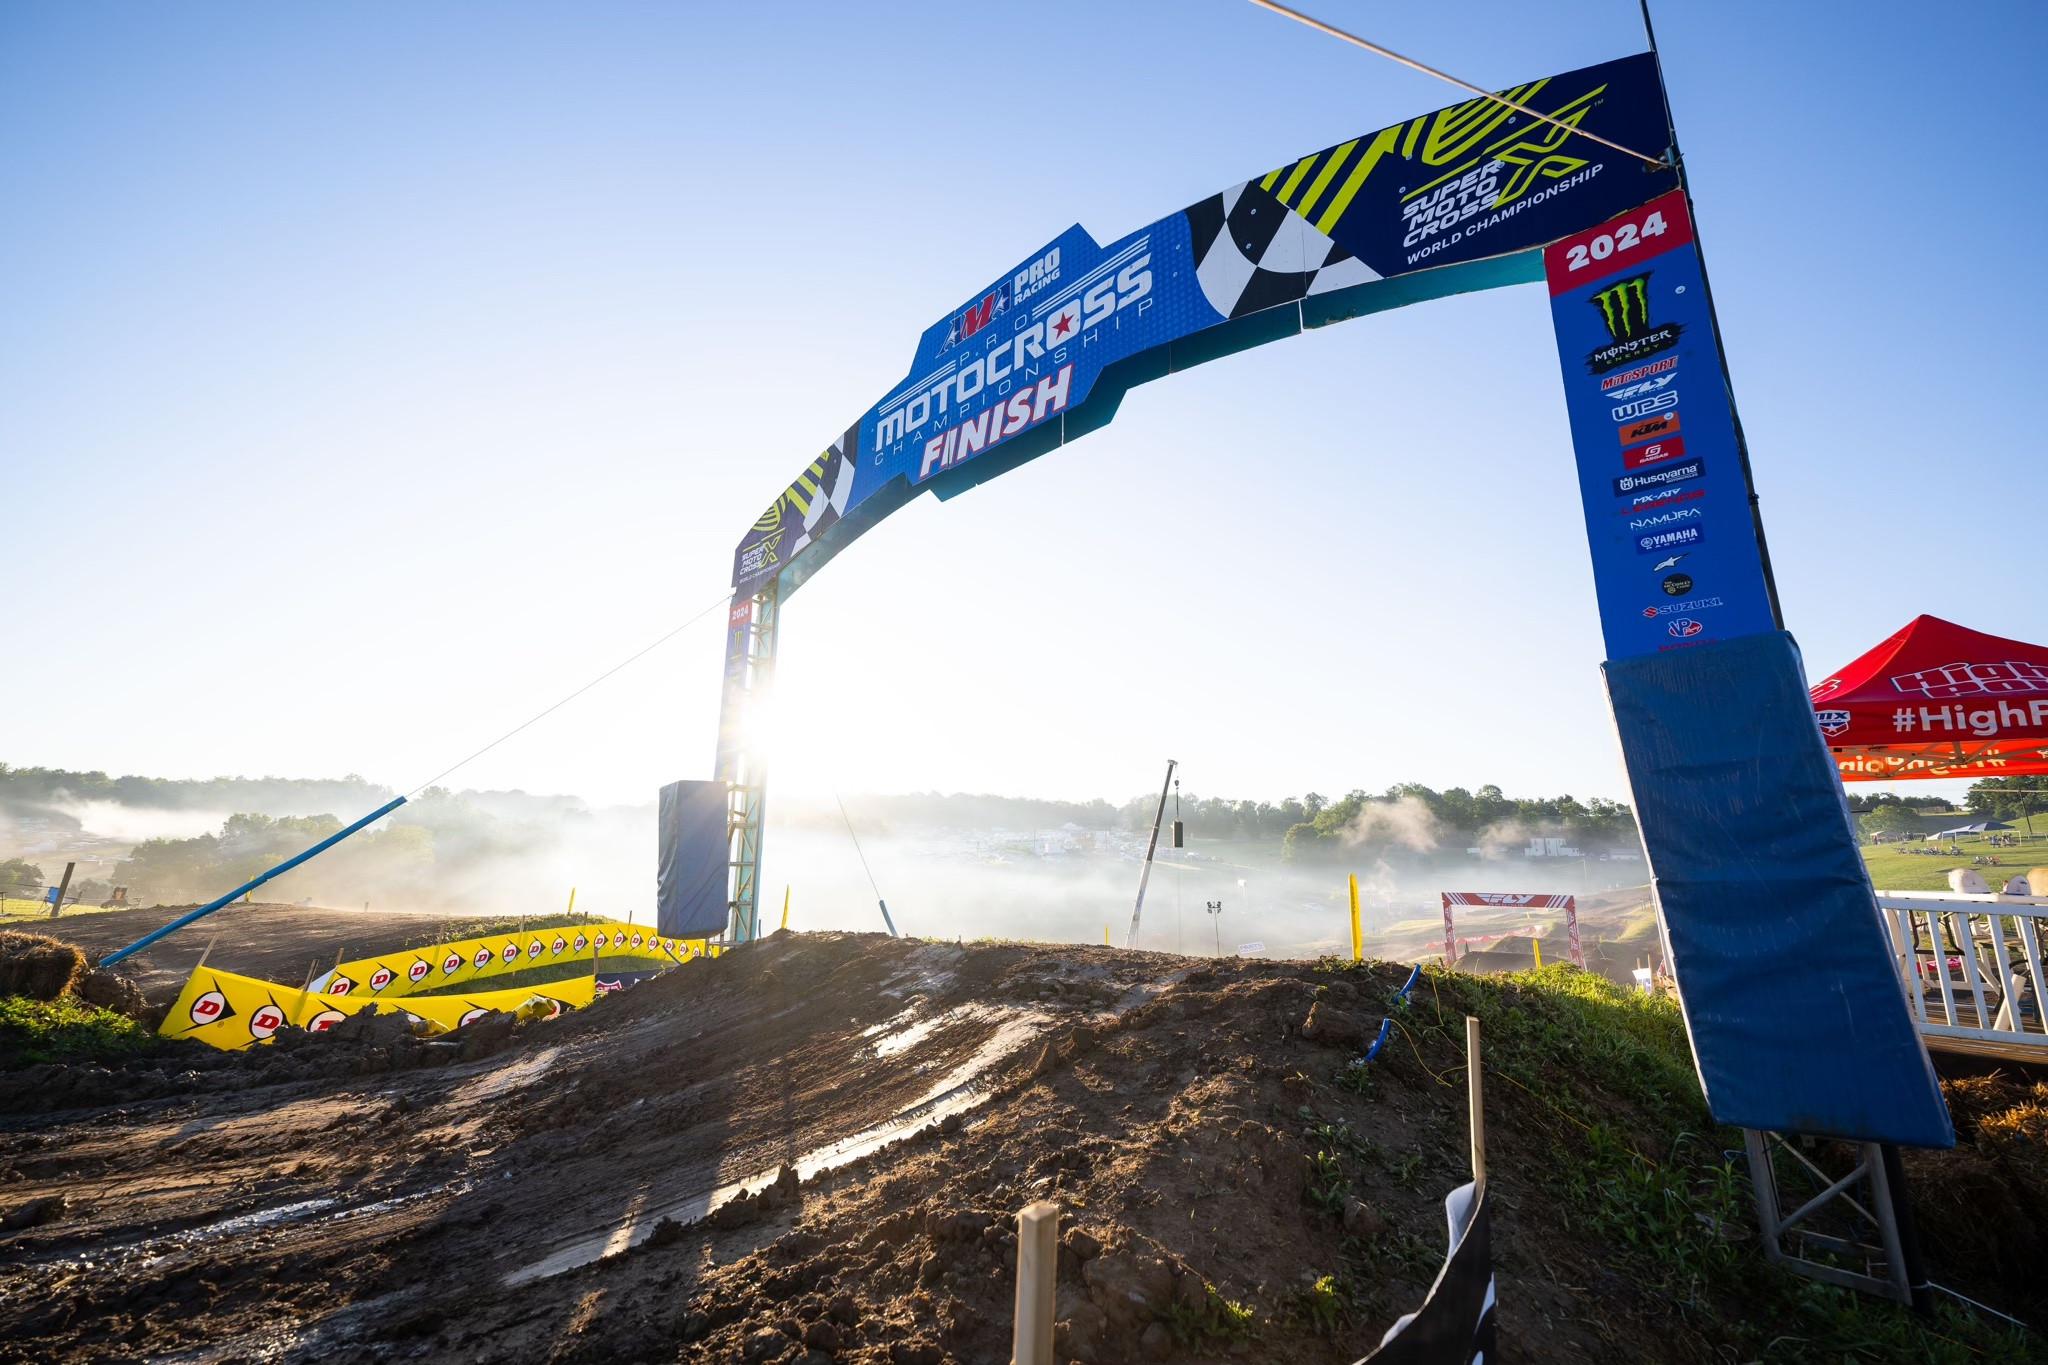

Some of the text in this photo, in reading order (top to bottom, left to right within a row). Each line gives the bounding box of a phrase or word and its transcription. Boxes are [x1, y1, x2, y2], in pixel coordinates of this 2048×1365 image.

[1401, 160, 1500, 221] SUPER
[1407, 164, 1604, 265] WORLD CHAMPIONSHIP
[1409, 176, 1497, 231] MOTO
[1403, 189, 1500, 247] CROSS
[1566, 211, 1668, 272] 2024
[1014, 246, 1060, 295] PRO
[1014, 267, 1060, 306] RACING
[935, 280, 1011, 359] AMA
[876, 252, 1152, 452] MOTOCROSS
[1606, 343, 1660, 365] ENERGY
[874, 297, 1153, 466] CHAMPIONSHIP
[1606, 372, 1678, 399] FLY
[1612, 390, 1679, 421] WPS
[918, 362, 1074, 480] FINISH
[1631, 420, 1668, 438] KTM
[1635, 465, 1697, 487] Husqvarna
[1633, 487, 1681, 505] MX-ATV
[1630, 508, 1701, 529] NAMURA
[1652, 528, 1698, 545] YAMAHA
[742, 545, 765, 561] SUPER
[742, 553, 762, 568] MOTO
[740, 560, 761, 575] CROSS
[732, 604, 749, 621] 2024
[1659, 597, 1721, 615] SUZUKI
[1668, 618, 1692, 637] VP
[1475, 893, 1536, 904] FLY
